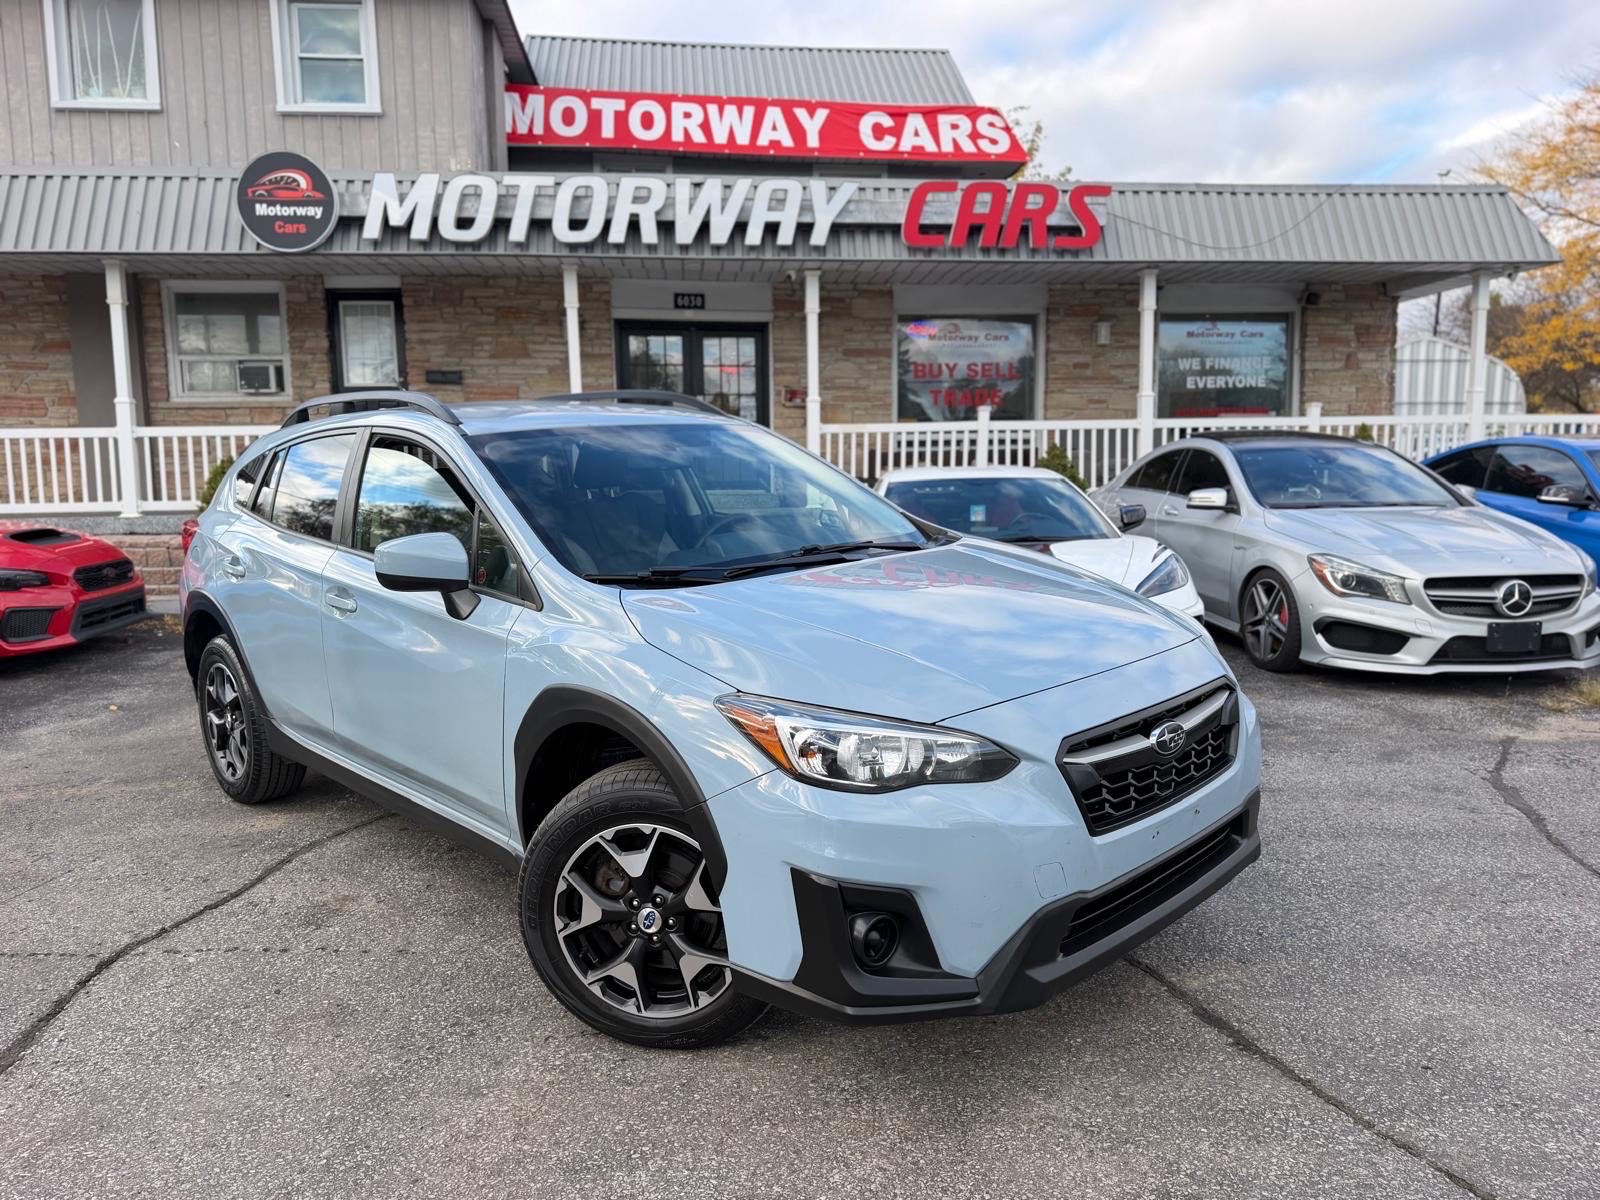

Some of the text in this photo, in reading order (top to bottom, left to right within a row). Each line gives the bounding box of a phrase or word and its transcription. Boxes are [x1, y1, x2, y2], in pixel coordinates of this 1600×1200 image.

[504, 92, 1011, 154] MOTORWAY CARS
[255, 203, 323, 219] Motorway
[361, 171, 1113, 249] MOTORWAY CARS
[274, 220, 307, 234] Cars
[1186, 330, 1264, 339] Motorway Cars
[912, 361, 1023, 379] BUY SELL
[1178, 356, 1272, 370] WE FINANCE
[1186, 375, 1267, 389] EVERYONE
